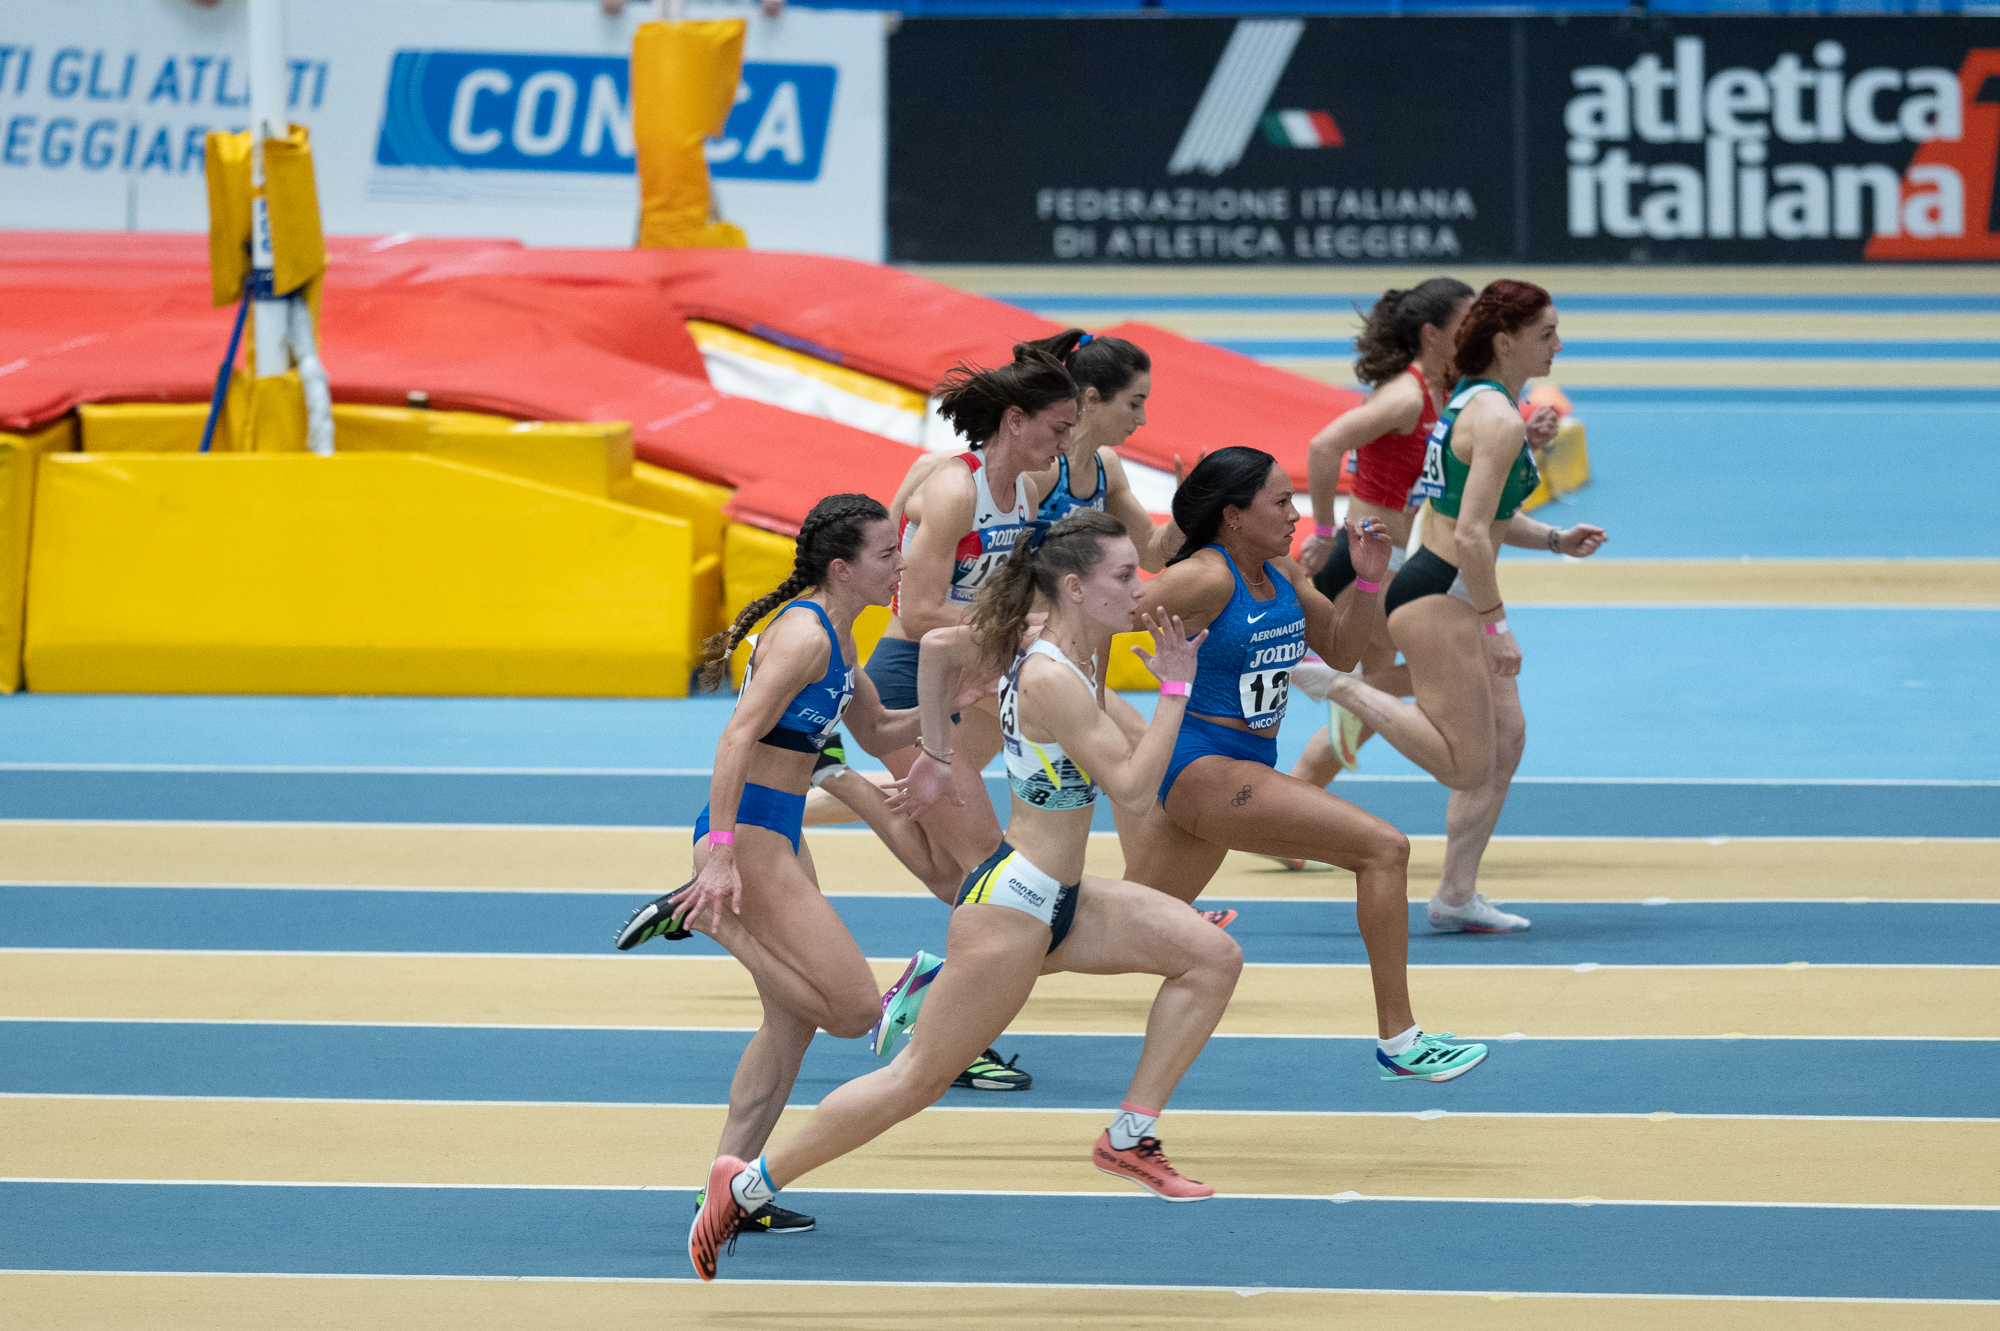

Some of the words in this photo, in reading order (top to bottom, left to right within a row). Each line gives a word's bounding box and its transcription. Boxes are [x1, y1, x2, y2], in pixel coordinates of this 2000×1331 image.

[48, 47, 137, 100] GLI
[147, 54, 329, 107] ATLTI
[1564, 36, 1964, 143] atletica
[1037, 187, 1289, 220] FEDERAZIONE
[1299, 187, 1476, 220] ITALIANA
[1566, 133, 1965, 240] italiana
[1052, 225, 1097, 258] DI
[1105, 225, 1285, 258] ATLETICA
[1294, 225, 1461, 258] LEGGERA
